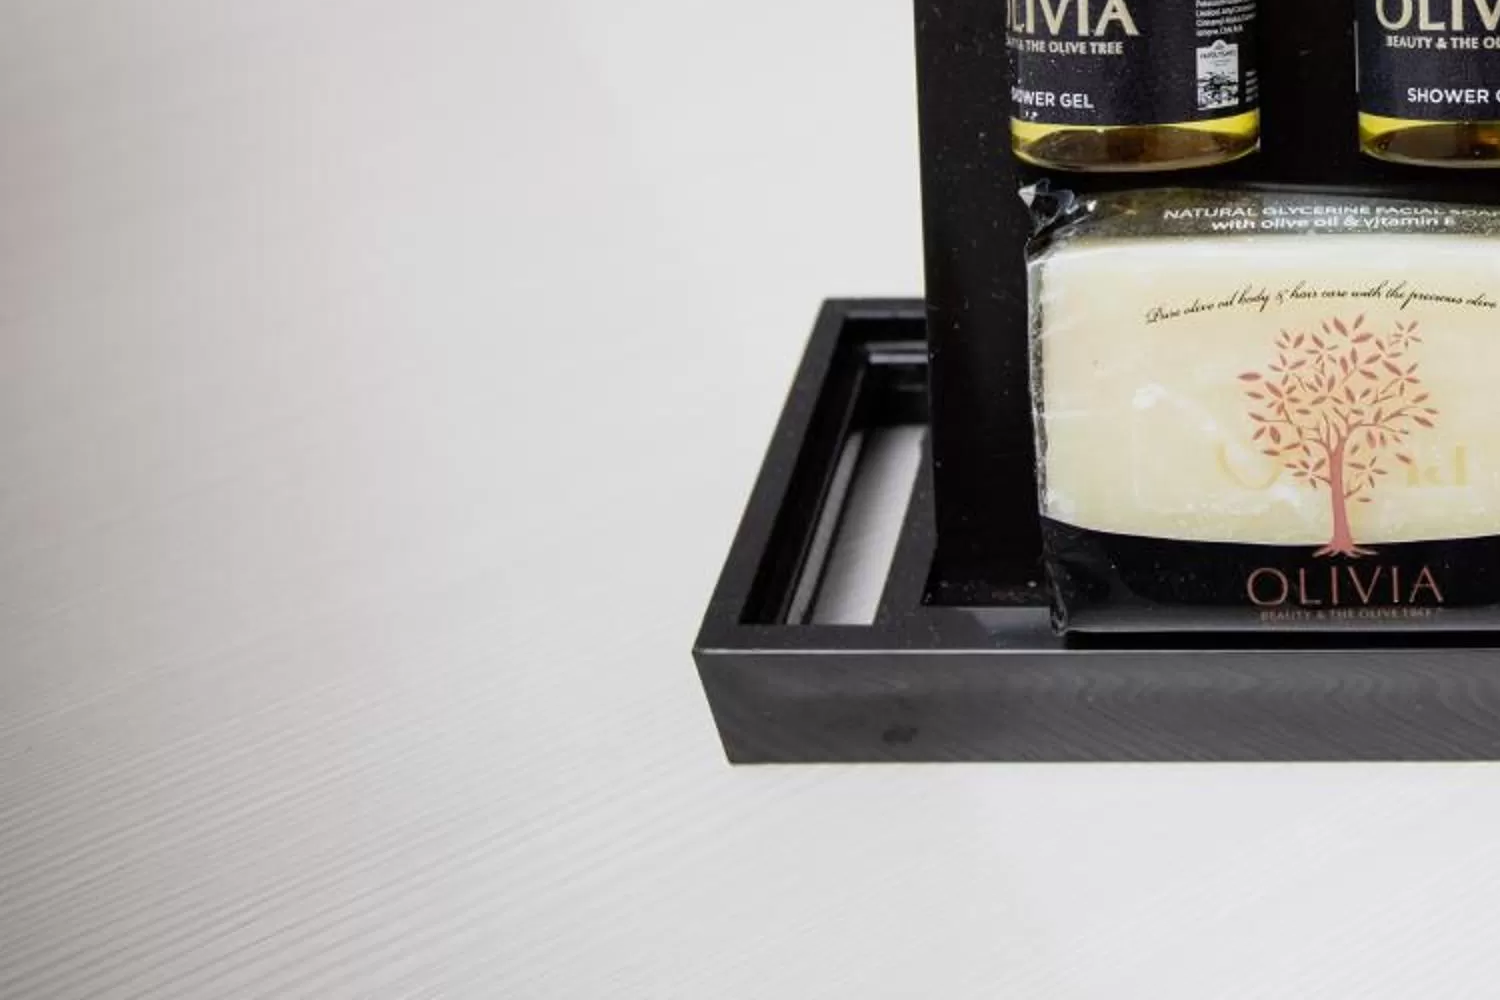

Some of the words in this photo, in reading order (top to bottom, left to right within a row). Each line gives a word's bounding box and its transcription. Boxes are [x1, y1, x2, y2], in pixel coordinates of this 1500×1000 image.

[1025, 39, 1046, 53] THE
[1048, 40, 1087, 55] OLIVE
[1090, 41, 1124, 56] TREE
[1386, 35, 1433, 50] BEAUTY
[1435, 37, 1448, 50] &
[1450, 36, 1479, 50] THE
[1060, 92, 1095, 109] GEL
[1407, 87, 1490, 104] SHOWER
[1163, 206, 1258, 220] NATURAL
[1263, 205, 1370, 216] GLYCERINE
[1375, 205, 1447, 216] FACIAL
[1211, 218, 1256, 231] with
[1261, 216, 1307, 229] olive
[1314, 215, 1338, 228] oil
[1343, 215, 1359, 228] &
[1363, 215, 1439, 229] vitamin
[1444, 216, 1457, 226] E
[1145, 307, 1181, 325] Pure
[1183, 299, 1215, 315] olive
[1217, 289, 1239, 309] oil
[1237, 282, 1270, 313] body
[1290, 279, 1318, 301] hair
[1321, 289, 1348, 298] care
[1351, 279, 1389, 299] with
[1386, 280, 1407, 299] the
[1399, 289, 1463, 311] precious
[1465, 292, 1498, 309] olive
[1246, 565, 1445, 606] OLIVIA
[1260, 609, 1311, 621] BEAUTY
[1331, 607, 1353, 619] THE
[1358, 606, 1398, 618] OLIVE
